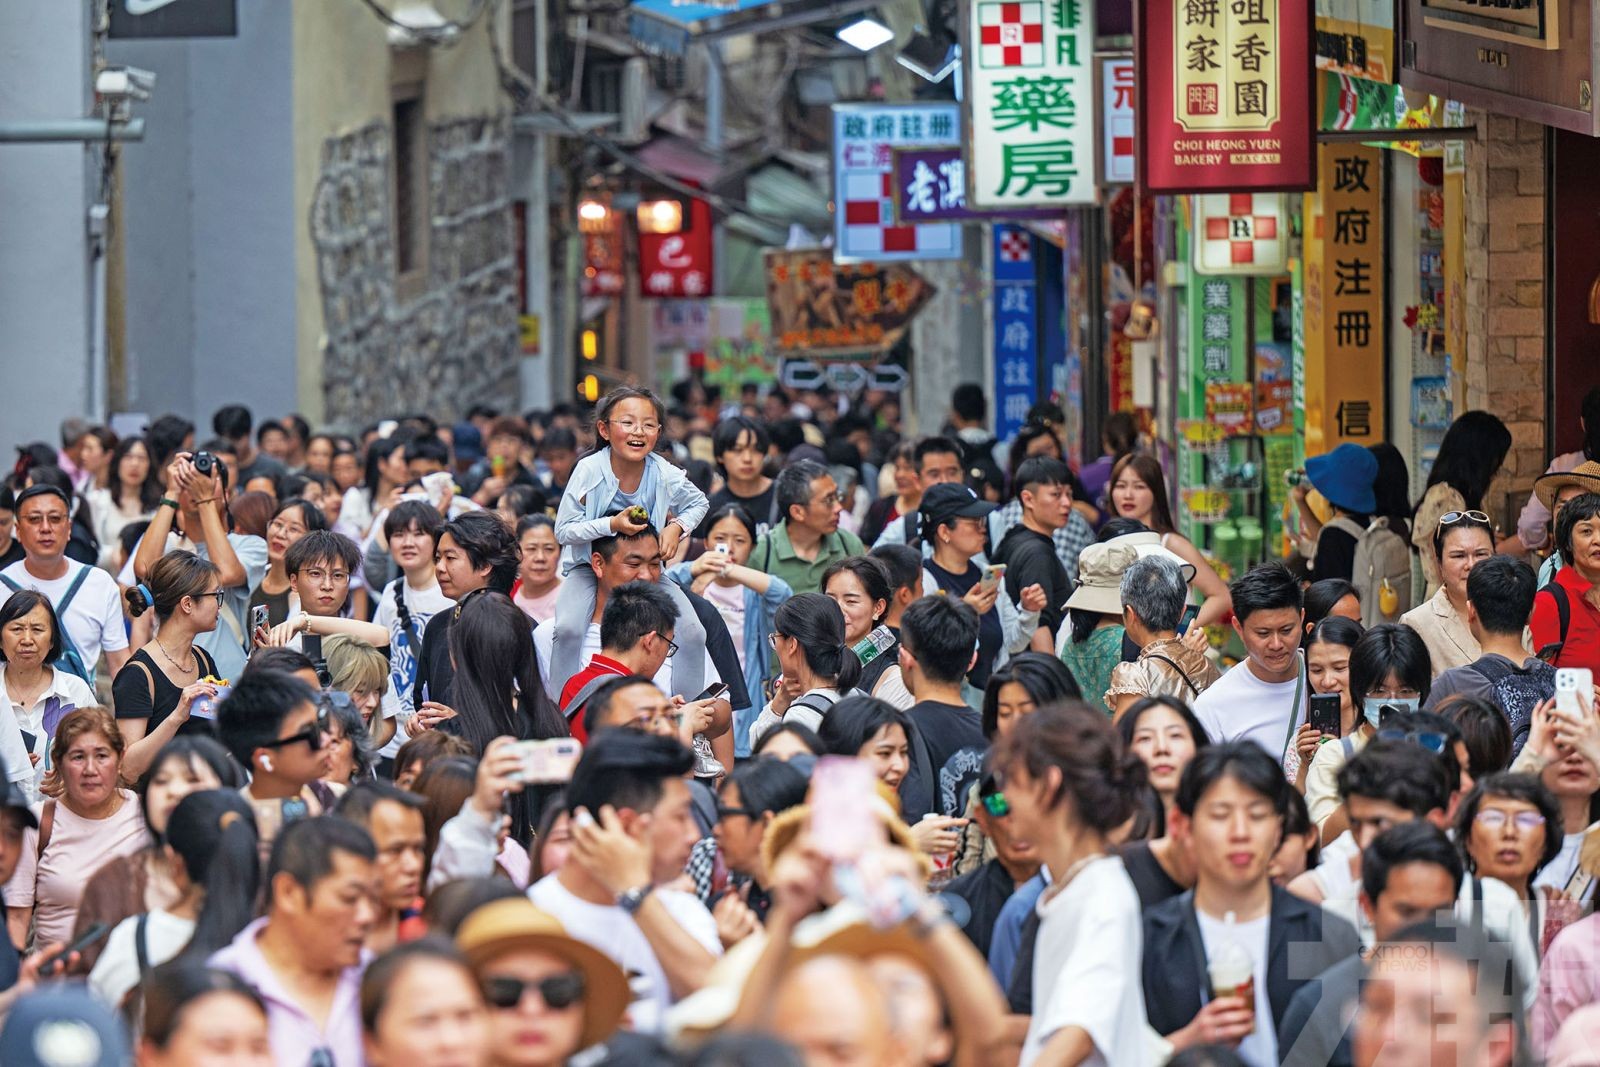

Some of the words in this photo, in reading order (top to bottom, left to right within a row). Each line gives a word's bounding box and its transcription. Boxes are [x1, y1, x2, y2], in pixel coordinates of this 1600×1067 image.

[1183, 0, 1222, 72] 餅家
[1231, 0, 1270, 117] 咀香園
[991, 76, 1078, 196] 藥房
[1174, 140, 1203, 151] CHOI
[1206, 139, 1247, 151] HEONG
[1249, 139, 1281, 150] YUEN
[1174, 154, 1223, 166] BAKERY
[1235, 154, 1277, 163] MACAU
[1333, 155, 1371, 347] 政府注冊
[1204, 281, 1231, 384] 業藥劑
[1335, 400, 1371, 437] 信
